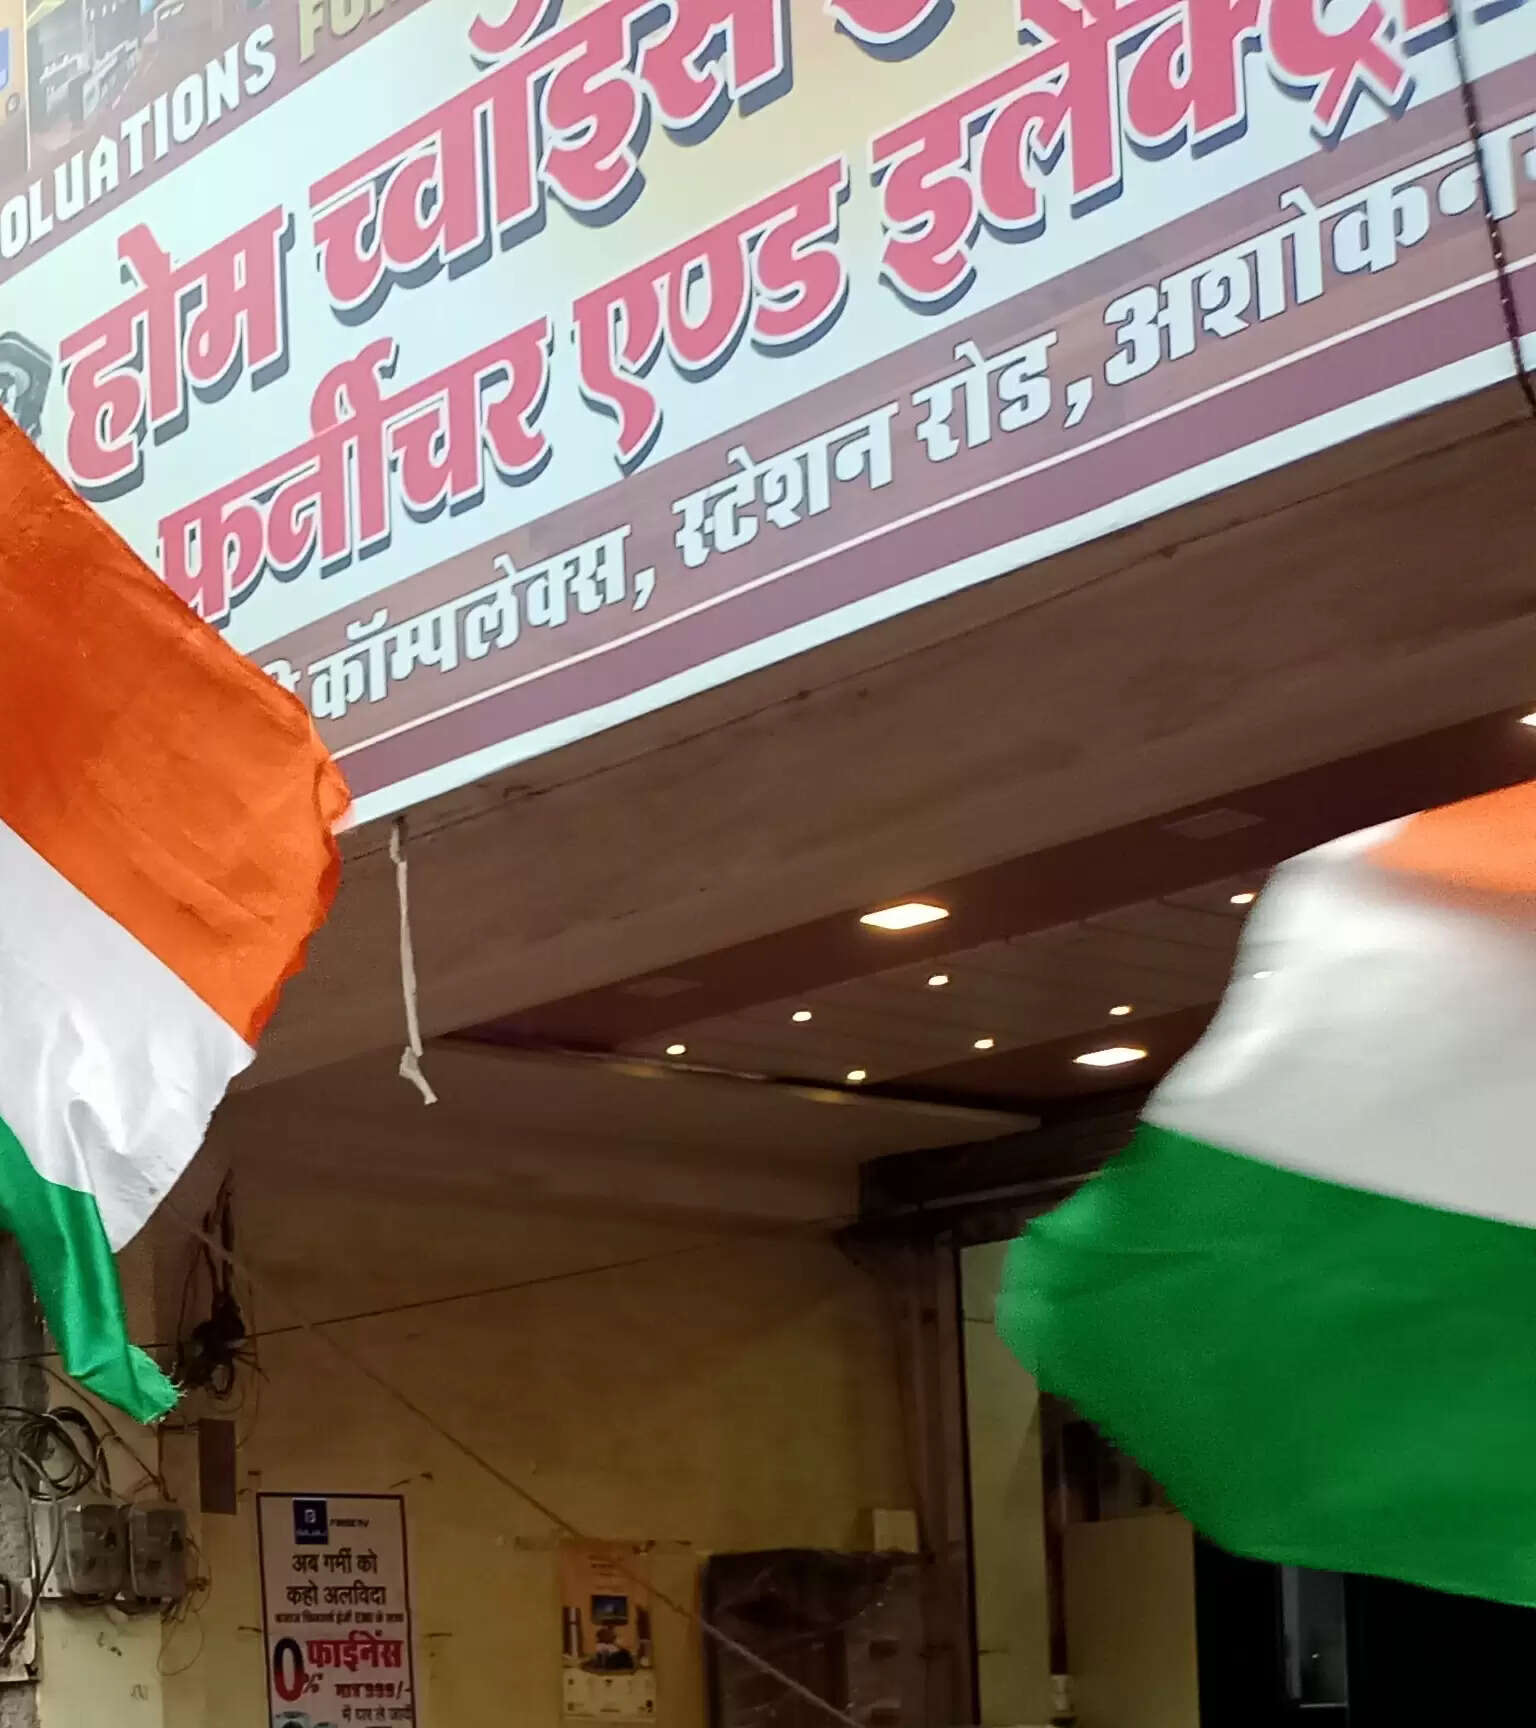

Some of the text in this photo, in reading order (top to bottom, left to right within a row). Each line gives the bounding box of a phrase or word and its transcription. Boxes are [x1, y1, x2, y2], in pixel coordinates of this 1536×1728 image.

[59, 212, 286, 482] होम
[157, 312, 549, 622] फर्नीचर
[573, 161, 846, 457] एण्ड
[671, 402, 900, 569] स्टेशन
[1103, 112, 1536, 388] अशोकन
[286, 1579, 386, 1606] कहो अलविदा
[292, 1547, 378, 1574] अब गर्मी को
